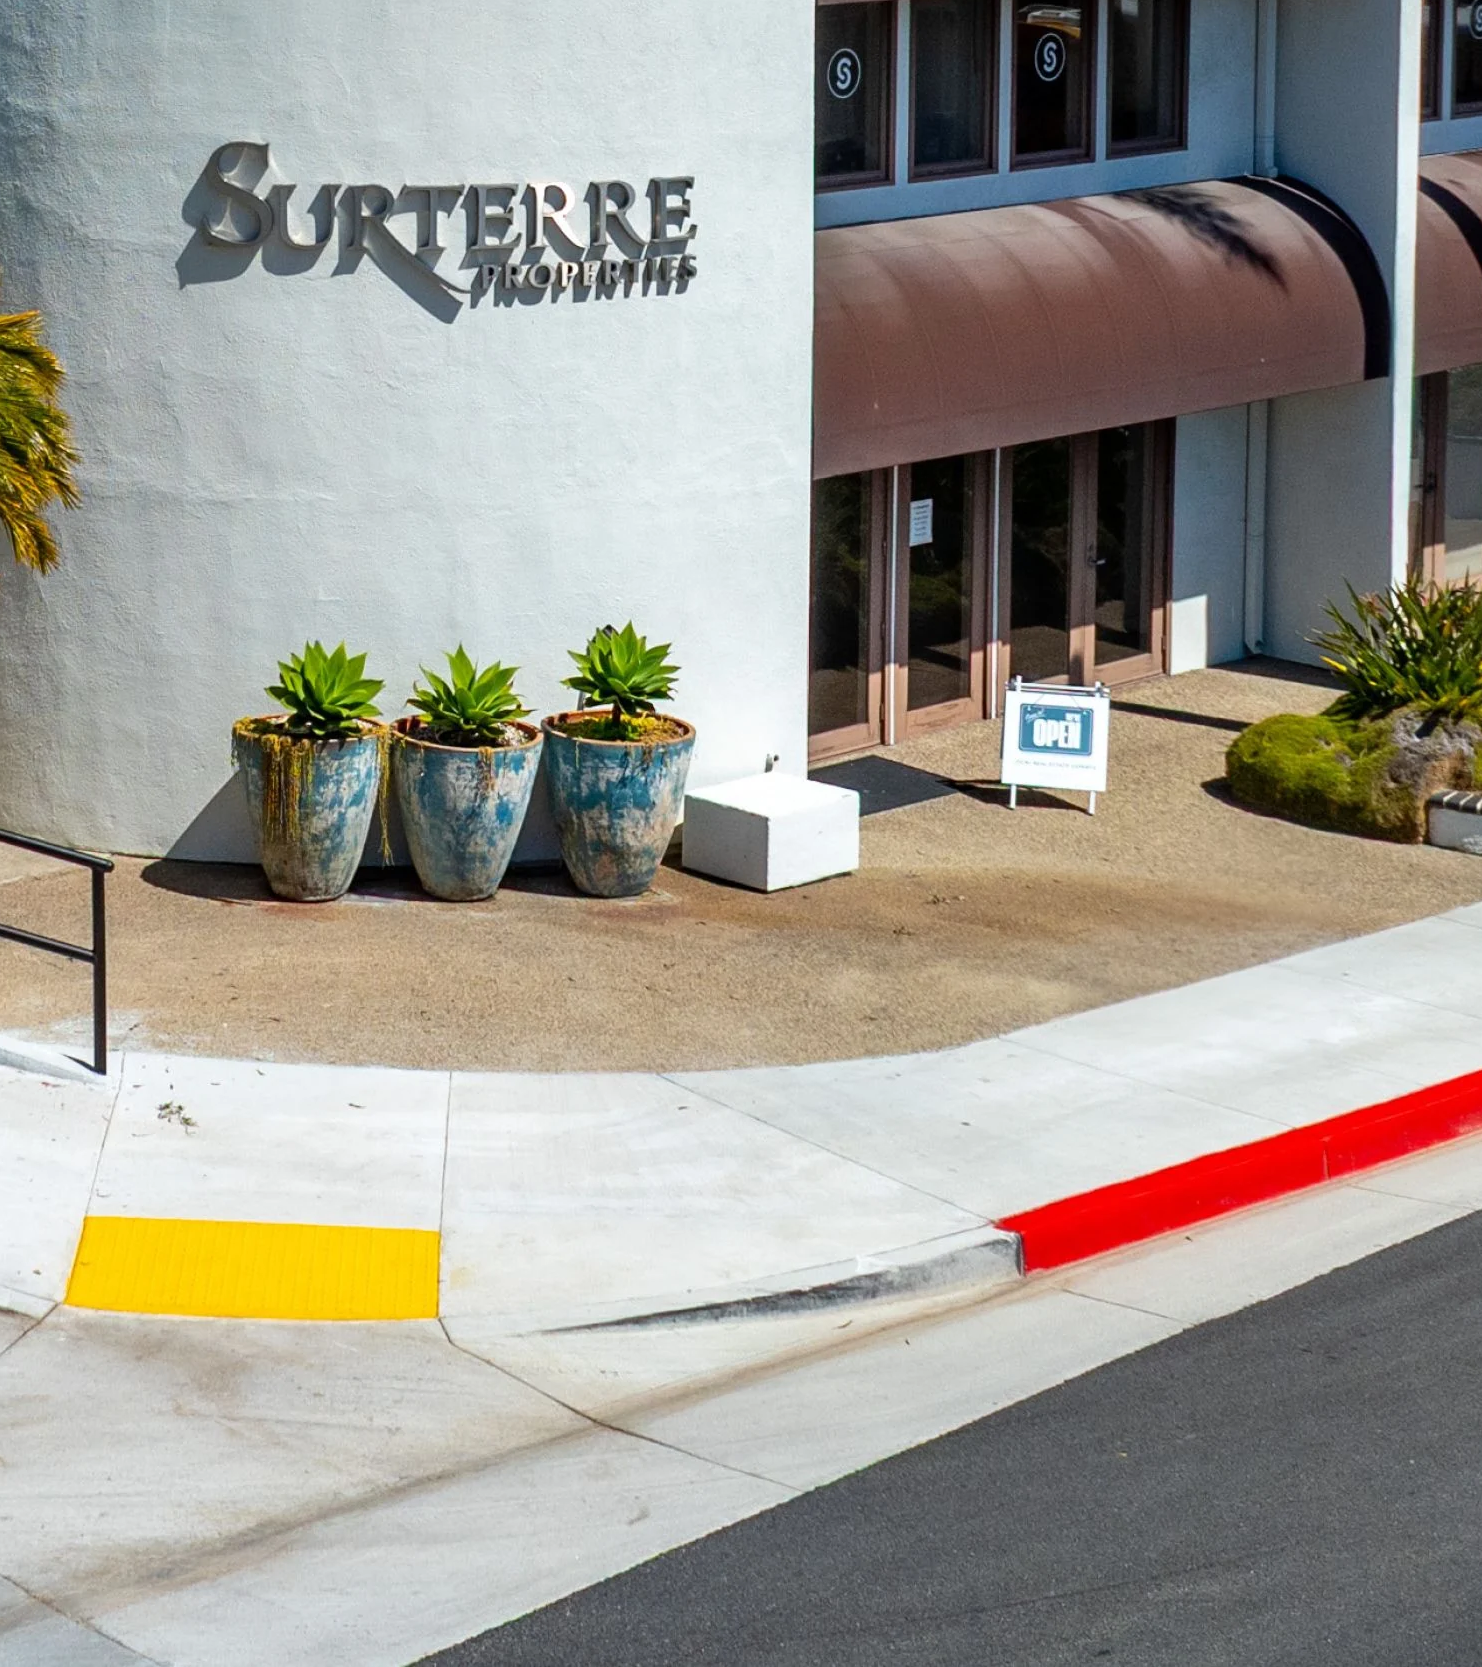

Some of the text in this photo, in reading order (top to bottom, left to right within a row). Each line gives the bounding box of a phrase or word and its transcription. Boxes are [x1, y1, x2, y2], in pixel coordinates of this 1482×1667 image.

[205, 140, 698, 293] SURTERRE
[480, 254, 699, 290] PROPERTIES
[1032, 718, 1081, 749] OPEN
